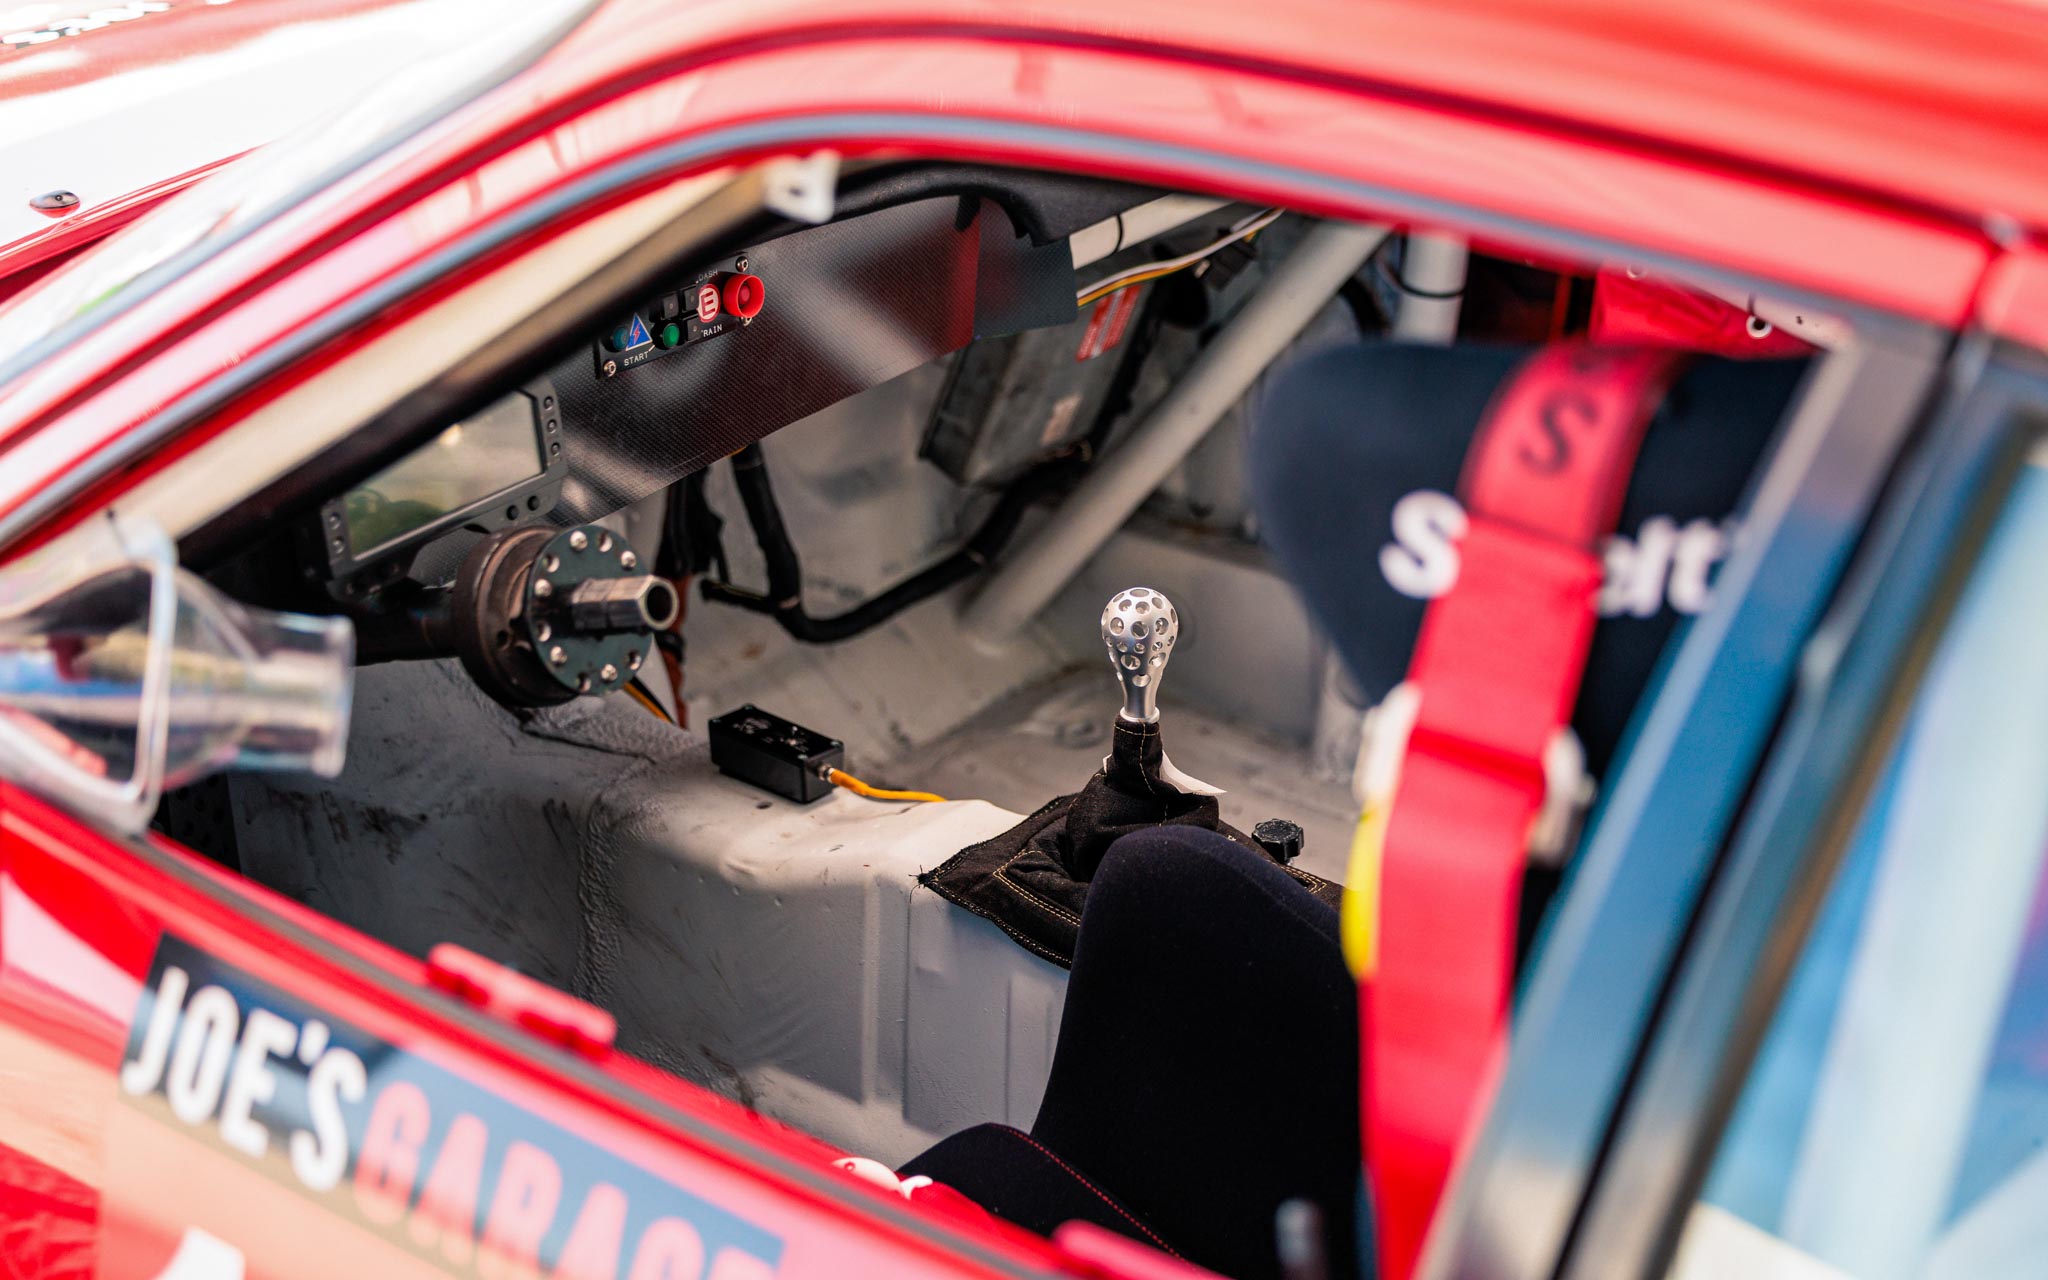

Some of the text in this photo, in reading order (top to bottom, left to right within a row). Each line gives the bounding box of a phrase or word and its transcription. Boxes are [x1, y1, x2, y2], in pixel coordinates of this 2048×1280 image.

[701, 291, 715, 316] E
[703, 324, 722, 337] RAIN
[624, 350, 649, 366] START
[120, 966, 783, 1280] JOE'S GARA
